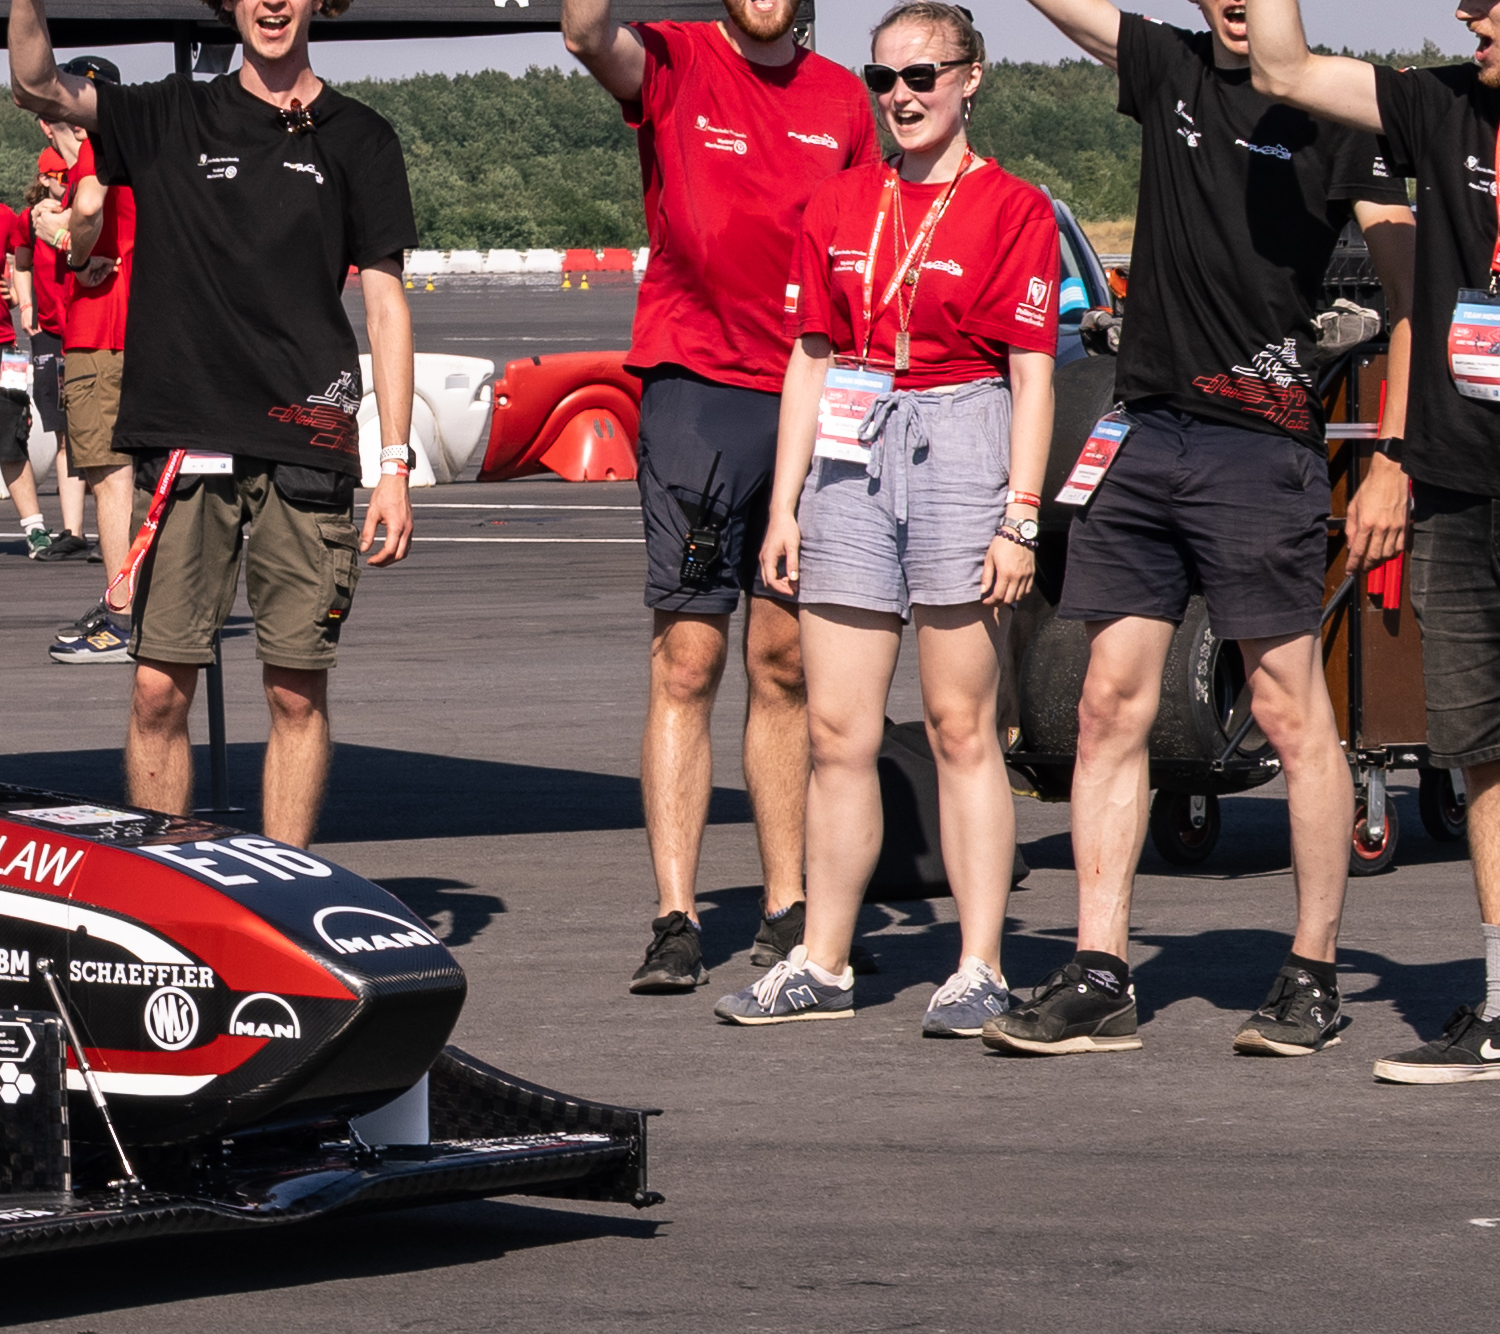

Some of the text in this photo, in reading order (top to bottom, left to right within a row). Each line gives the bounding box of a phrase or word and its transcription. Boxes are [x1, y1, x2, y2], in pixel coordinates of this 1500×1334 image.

[137, 837, 333, 886] E16
[335, 930, 431, 954] MAN
[69, 960, 215, 988] SCHAEFFLER
[235, 1021, 294, 1038] MAN
